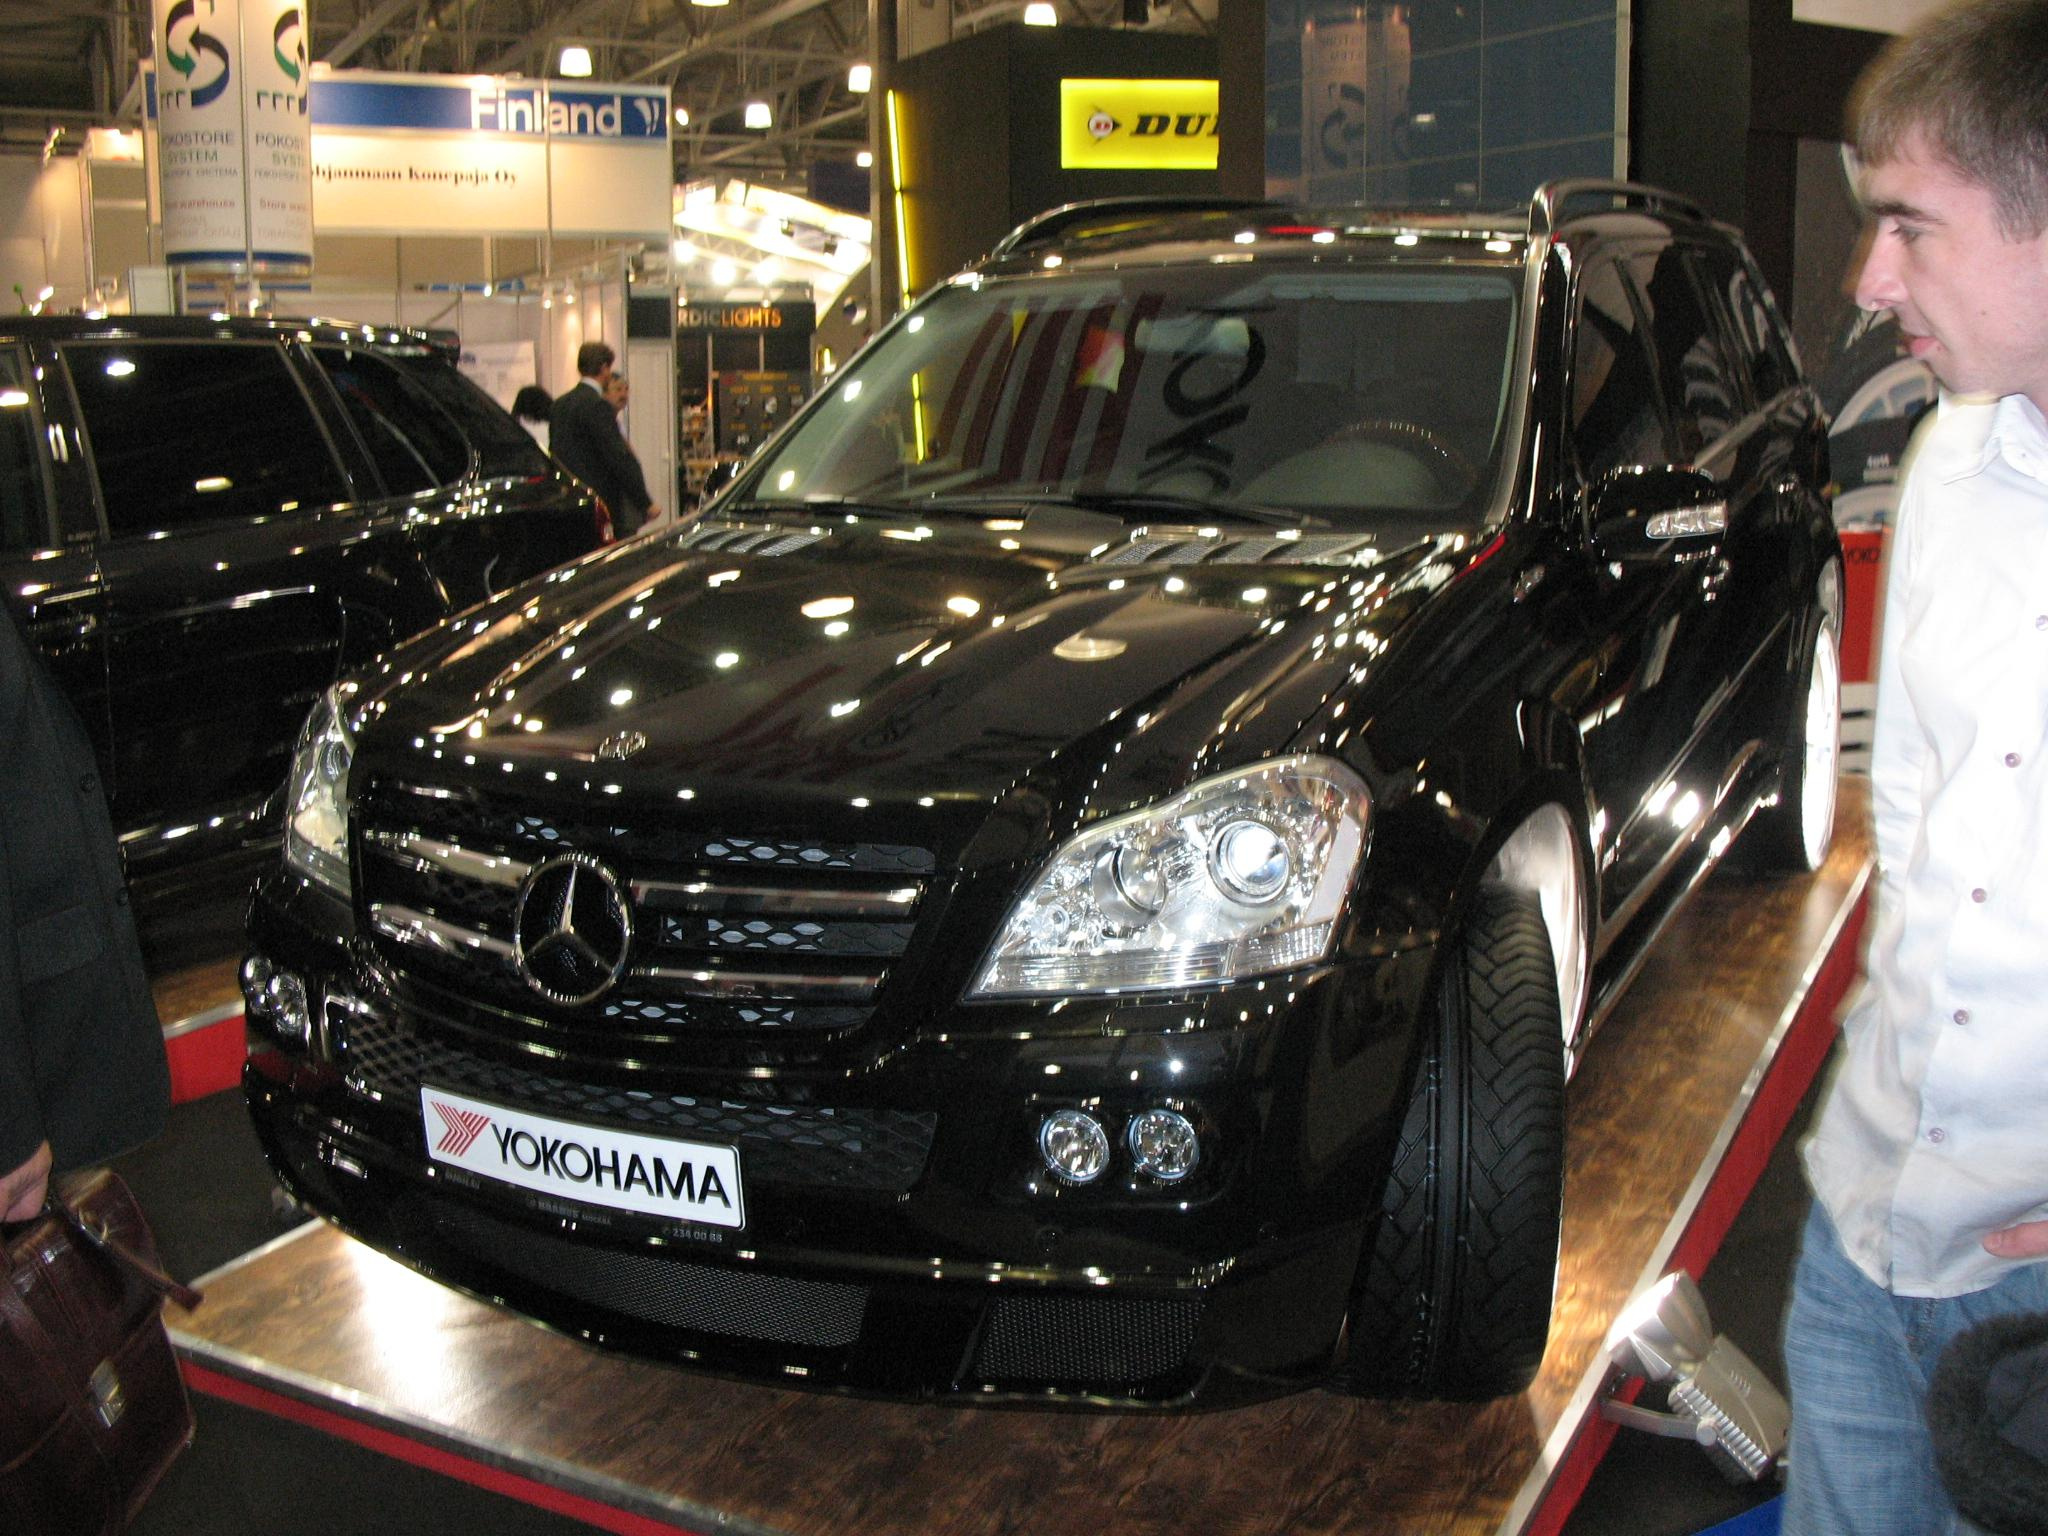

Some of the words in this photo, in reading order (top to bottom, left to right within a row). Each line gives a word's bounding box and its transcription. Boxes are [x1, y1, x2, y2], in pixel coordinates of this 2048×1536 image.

[470, 87, 622, 136] Finland
[311, 163, 403, 182] hjanmaan
[494, 170, 517, 189] Oy
[490, 1122, 732, 1209] YOKOHAMA
